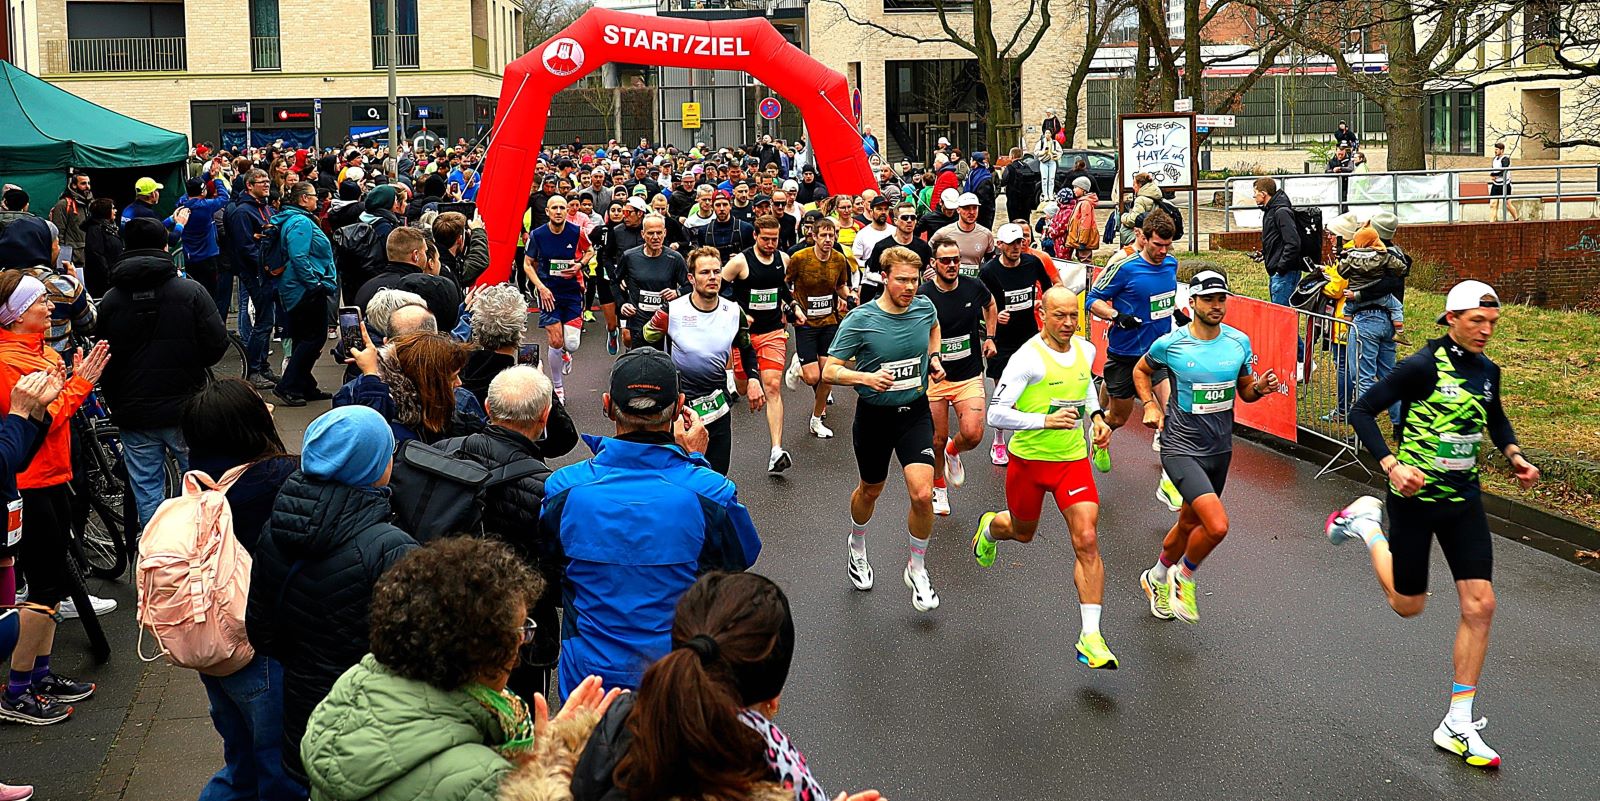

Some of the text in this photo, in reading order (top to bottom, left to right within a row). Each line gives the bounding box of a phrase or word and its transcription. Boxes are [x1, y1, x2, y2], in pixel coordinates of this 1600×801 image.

[603, 25, 750, 56] START/ZIEL
[643, 295, 661, 304] 2100
[758, 294, 771, 302] 381
[1010, 293, 1028, 303] 2130
[1157, 298, 1171, 308] 419
[812, 300, 828, 308] 2160
[946, 342, 962, 352] 285
[1204, 389, 1225, 401] 404
[701, 400, 719, 412] 421
